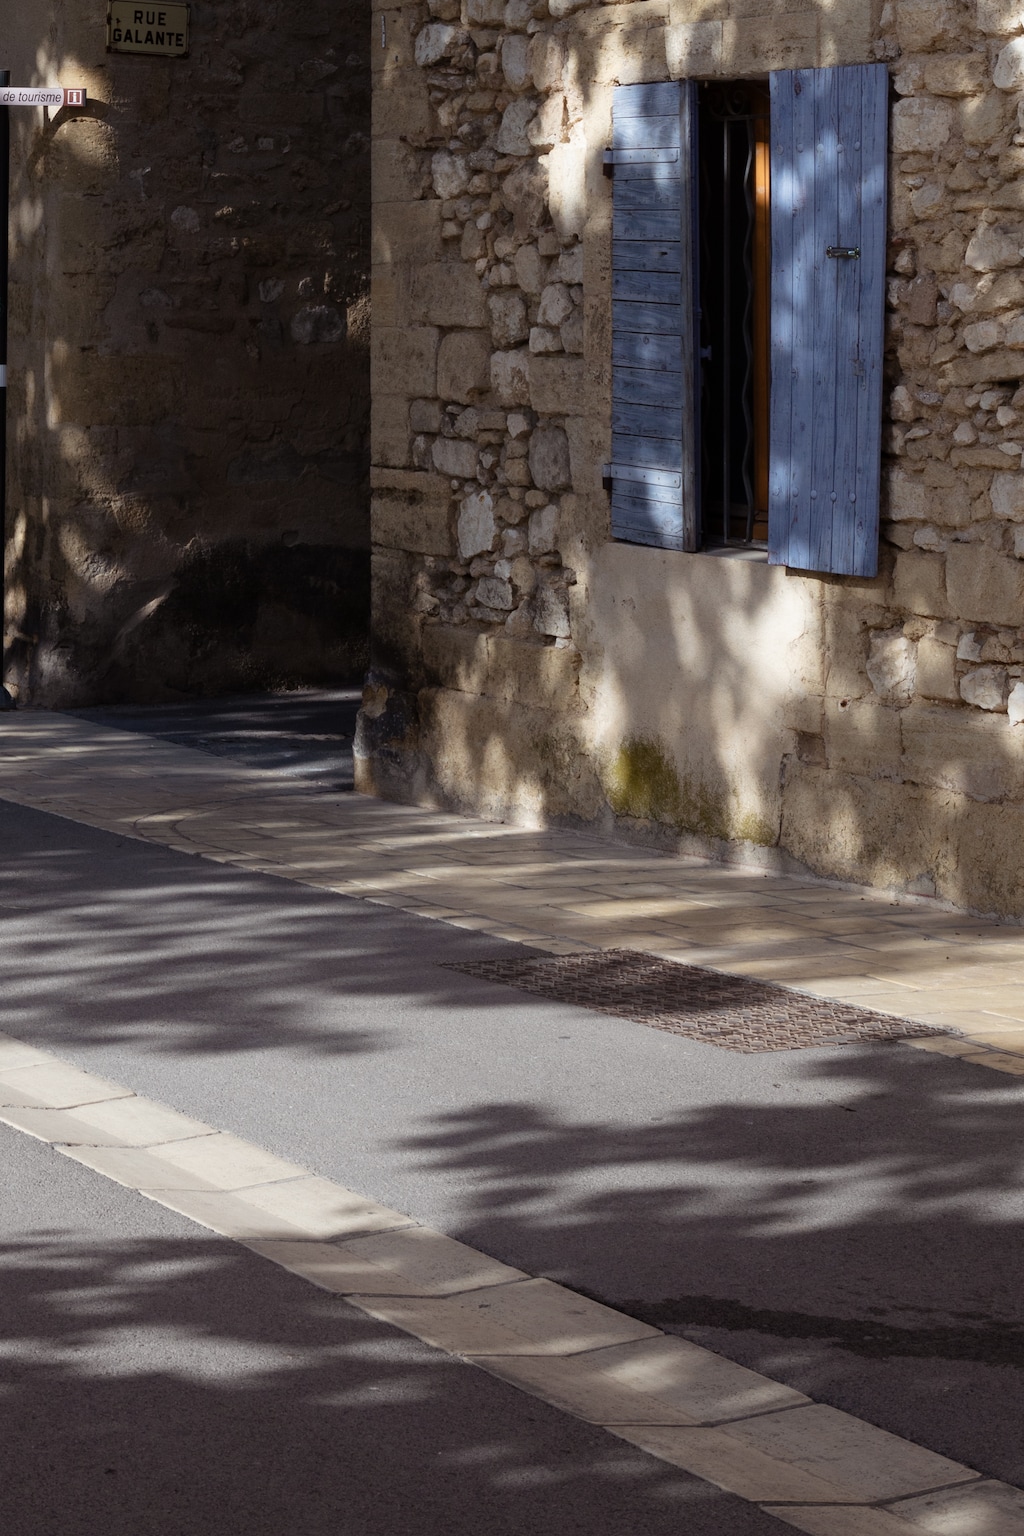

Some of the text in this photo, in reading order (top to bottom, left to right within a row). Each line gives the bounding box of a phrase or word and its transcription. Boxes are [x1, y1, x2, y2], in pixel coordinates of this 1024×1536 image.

[134, 10, 167, 26] RUE
[113, 29, 184, 47] GALANTE
[3, 91, 16, 102] de
[18, 92, 62, 103] tourisme
